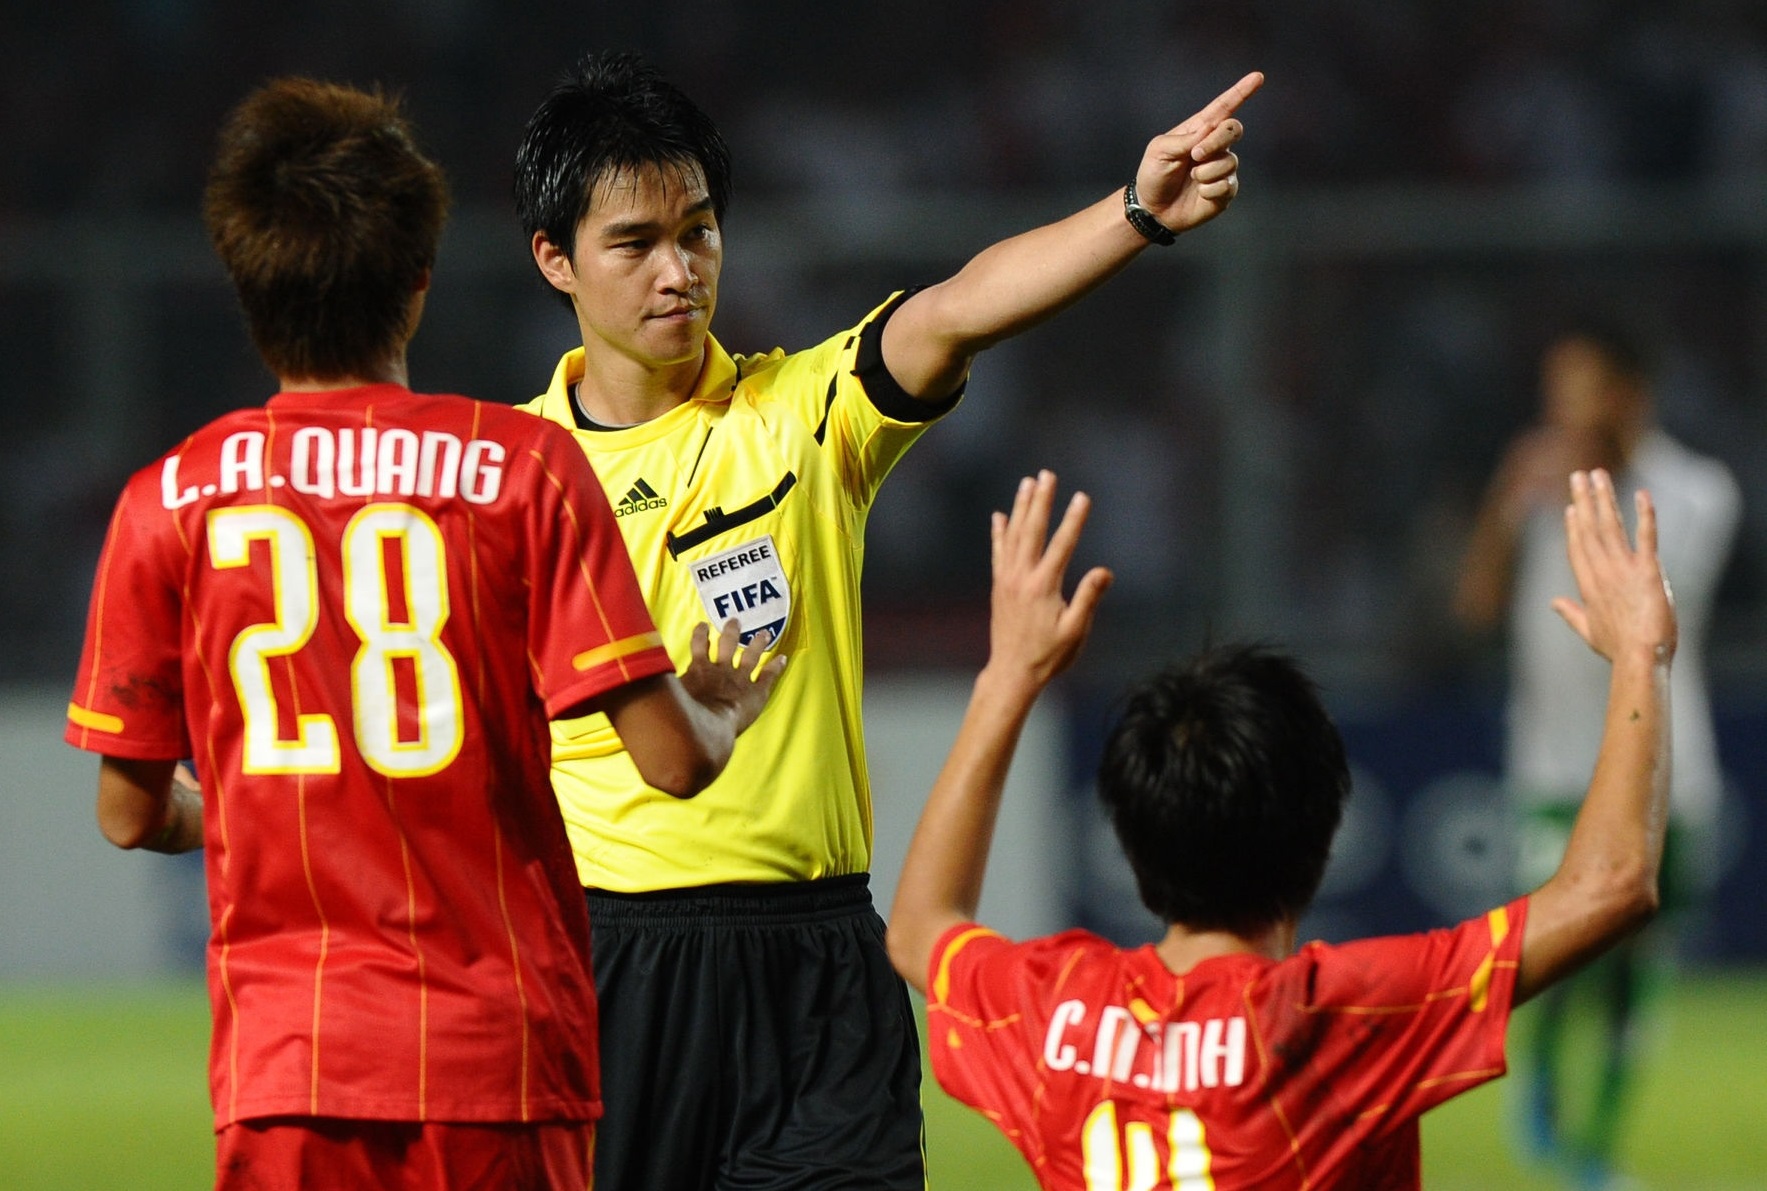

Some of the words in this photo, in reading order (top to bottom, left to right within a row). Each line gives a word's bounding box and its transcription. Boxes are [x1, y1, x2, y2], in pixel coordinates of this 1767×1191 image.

[161, 426, 506, 510] L.A.QUANG
[614, 497, 668, 518] adidas
[697, 545, 772, 582] REFEREE
[206, 502, 465, 779] 28
